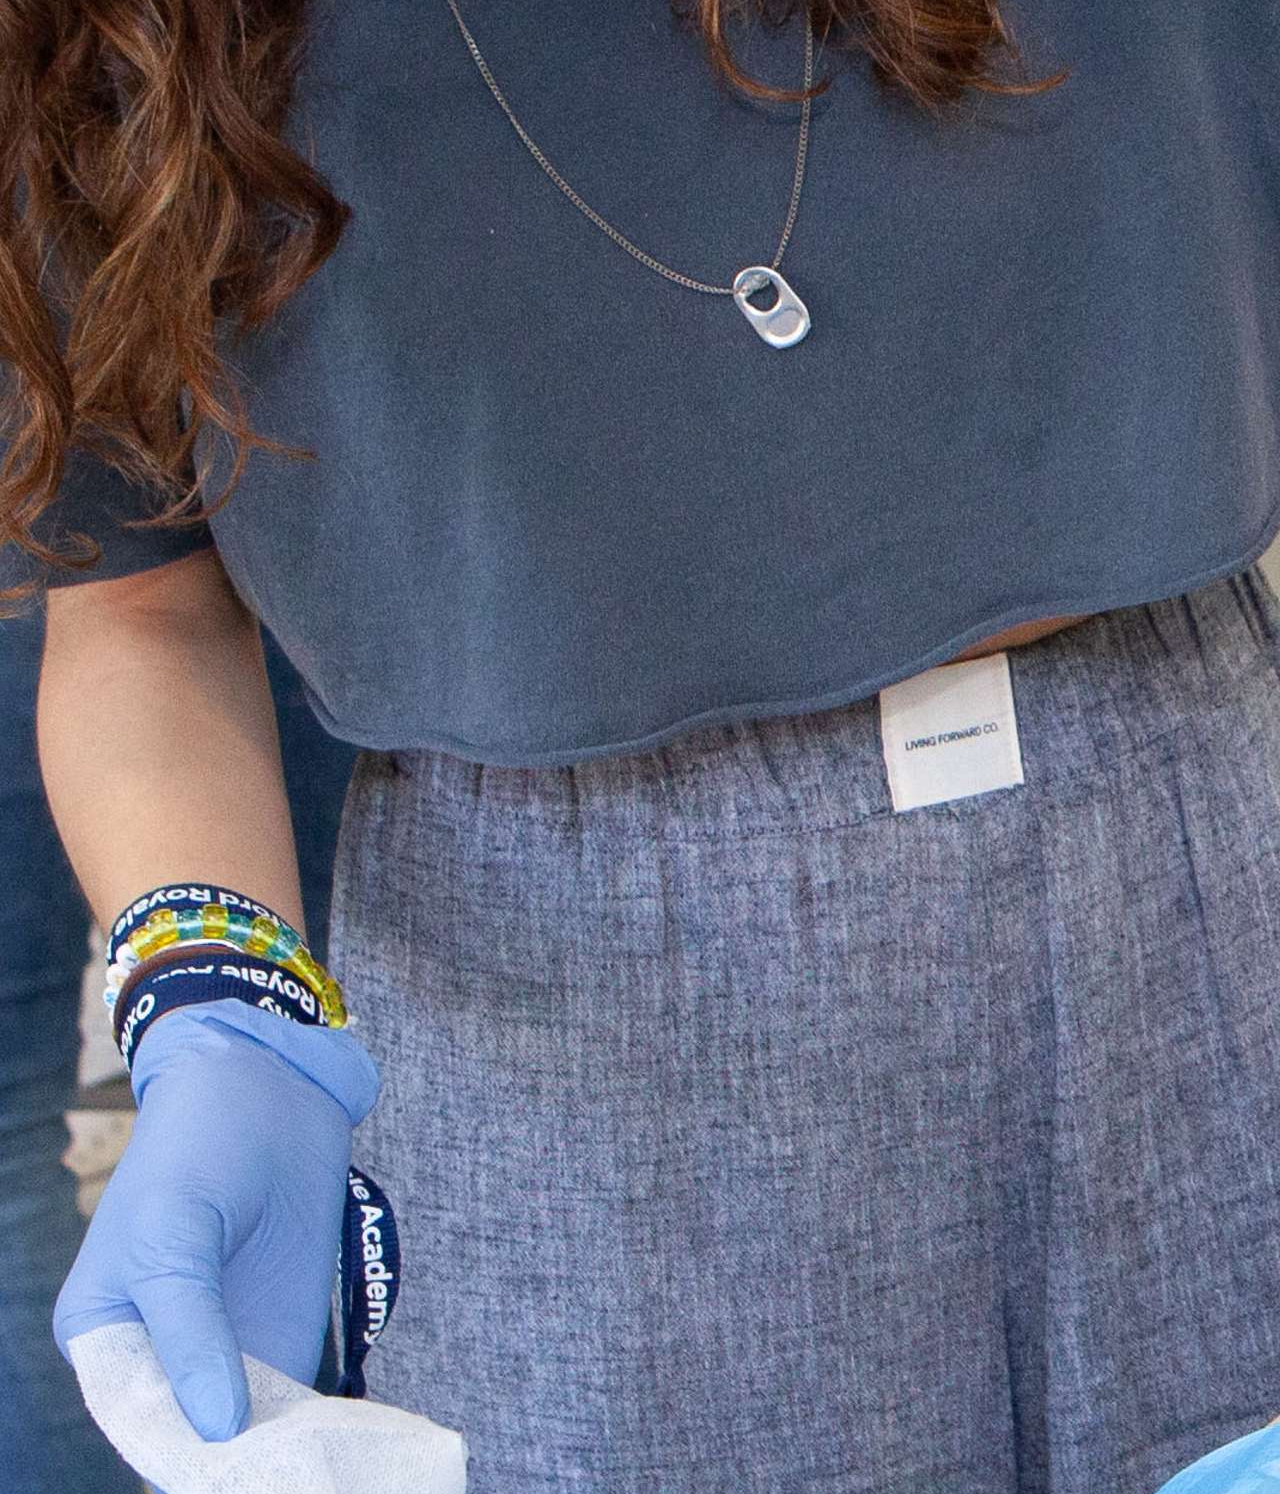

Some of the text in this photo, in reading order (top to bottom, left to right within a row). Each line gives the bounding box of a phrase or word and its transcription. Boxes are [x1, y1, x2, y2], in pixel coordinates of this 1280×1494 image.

[938, 726, 981, 744] FORWARD
[114, 887, 212, 936] Royale
[360, 1204, 393, 1346] Academy
